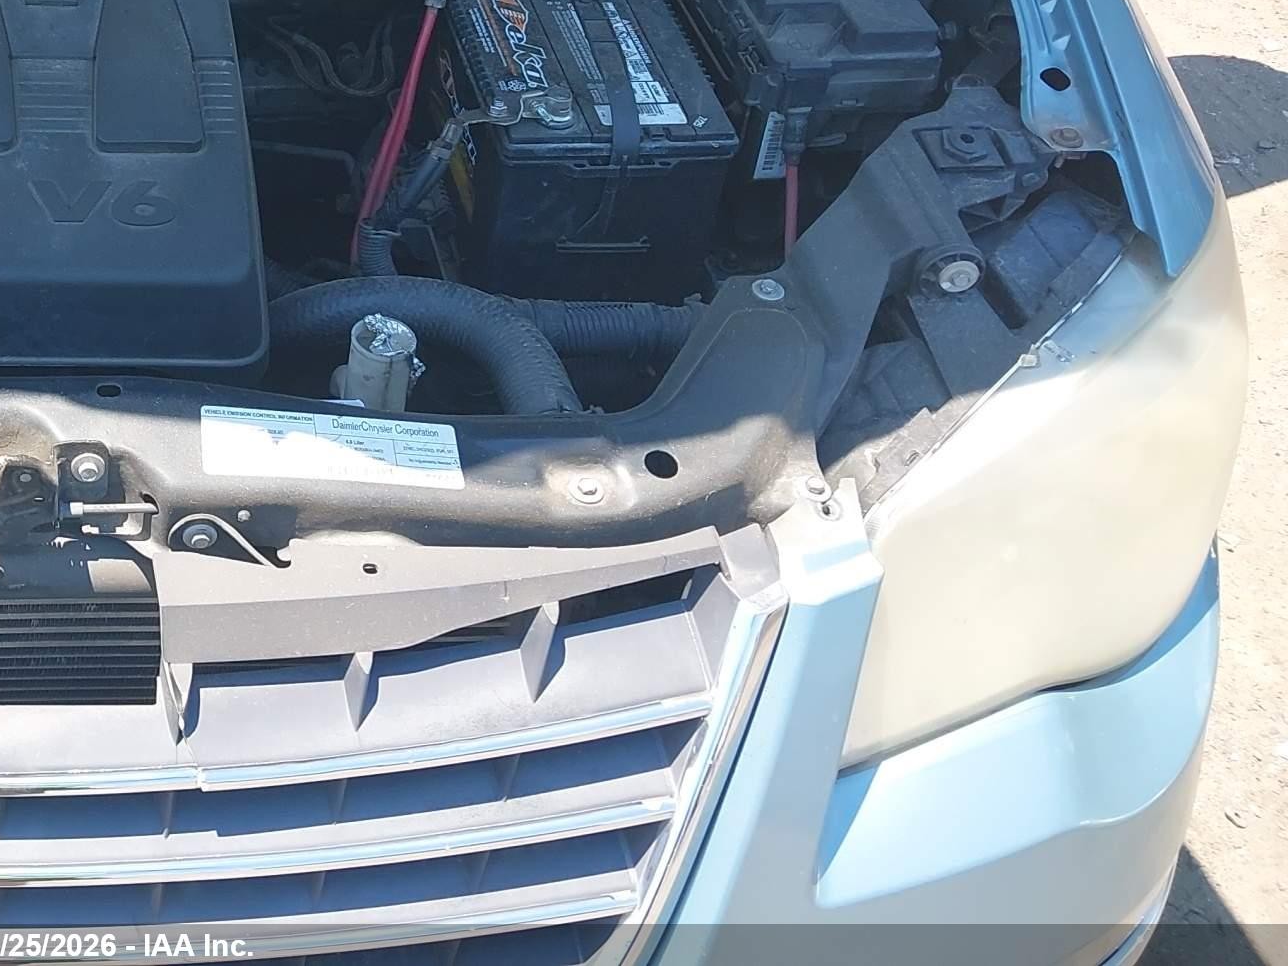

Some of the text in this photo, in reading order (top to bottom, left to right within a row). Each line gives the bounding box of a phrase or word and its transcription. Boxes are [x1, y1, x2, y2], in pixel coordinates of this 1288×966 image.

[29, 178, 178, 228] V6
[331, 418, 440, 438] DaimlerChrysler Corporation
